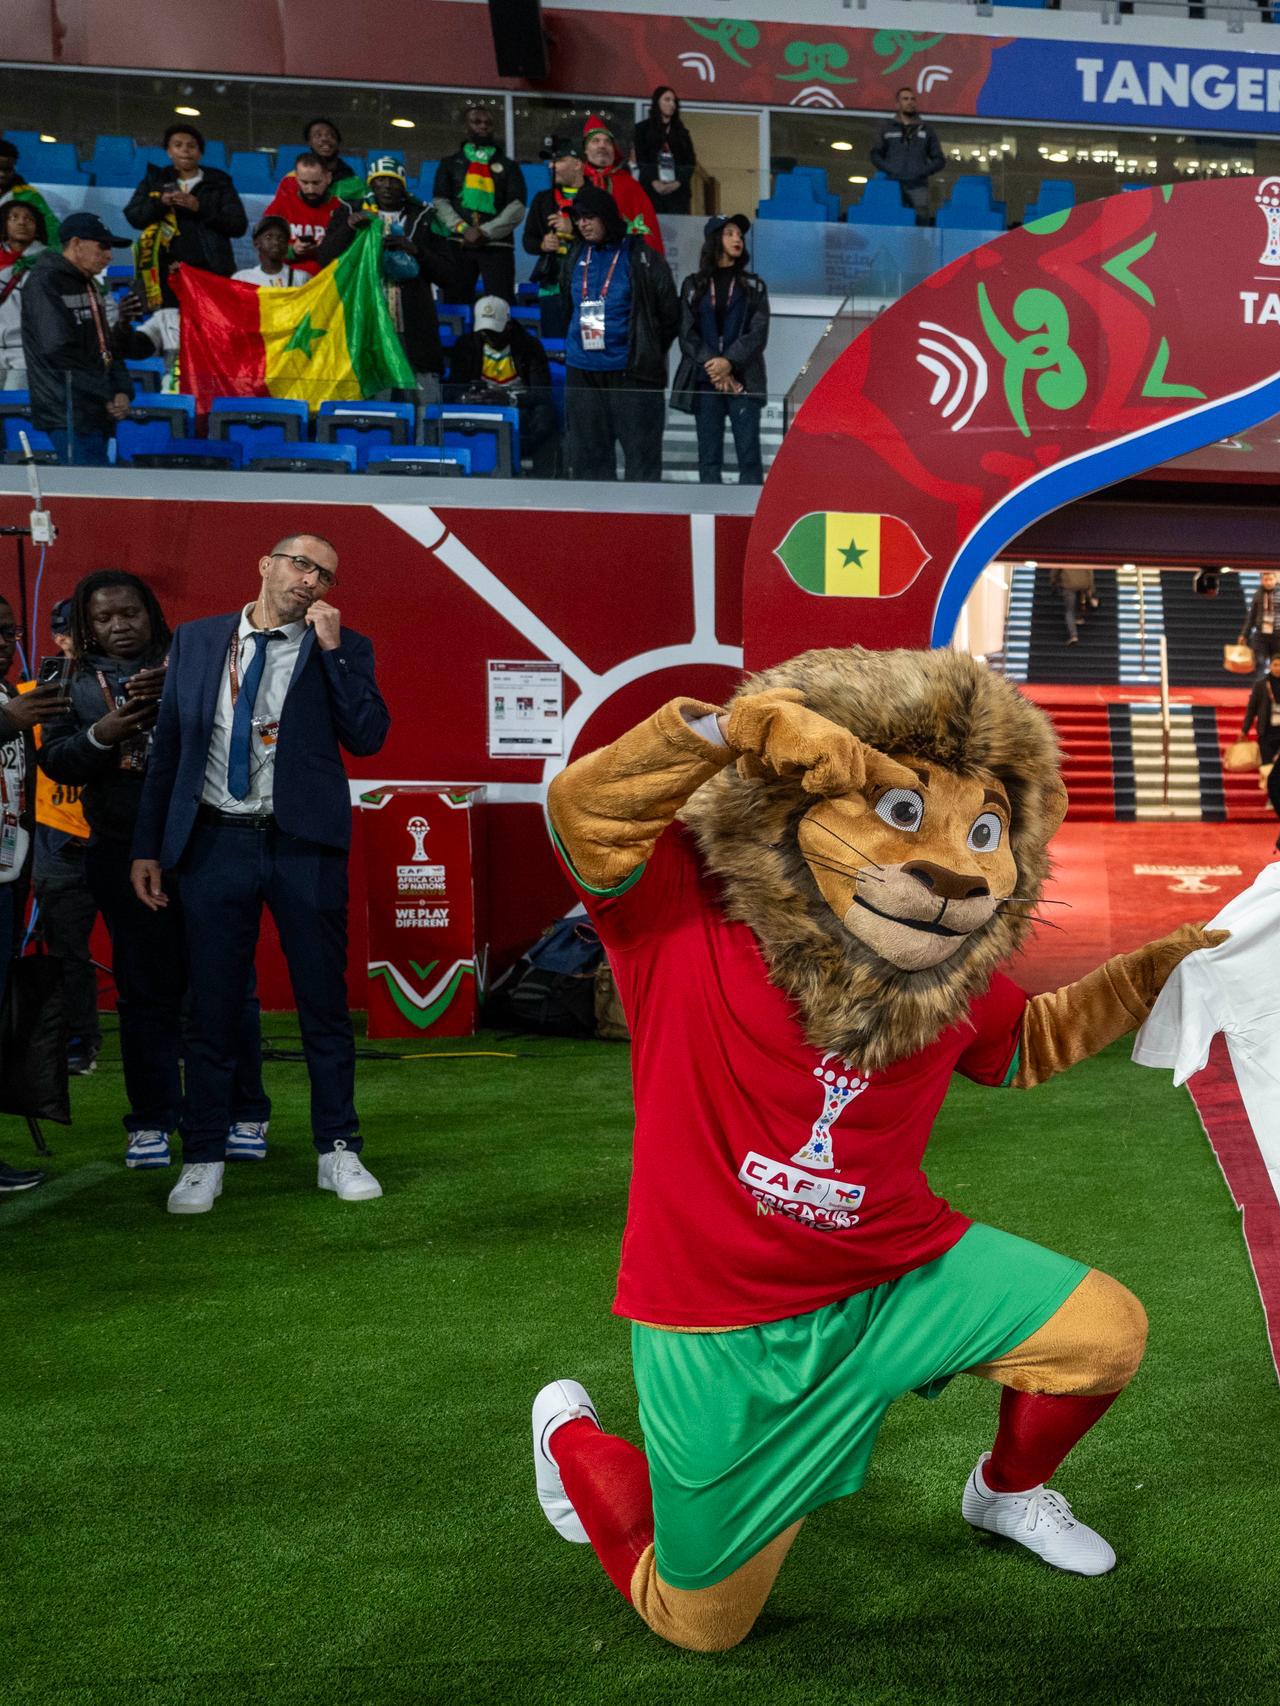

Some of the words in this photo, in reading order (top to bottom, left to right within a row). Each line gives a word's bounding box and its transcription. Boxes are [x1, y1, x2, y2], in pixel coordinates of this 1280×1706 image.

[395, 909, 416, 919] WE
[418, 909, 449, 919] PLAY
[395, 919, 449, 928] DIFFERENT
[745, 1161, 815, 1194] CAF
